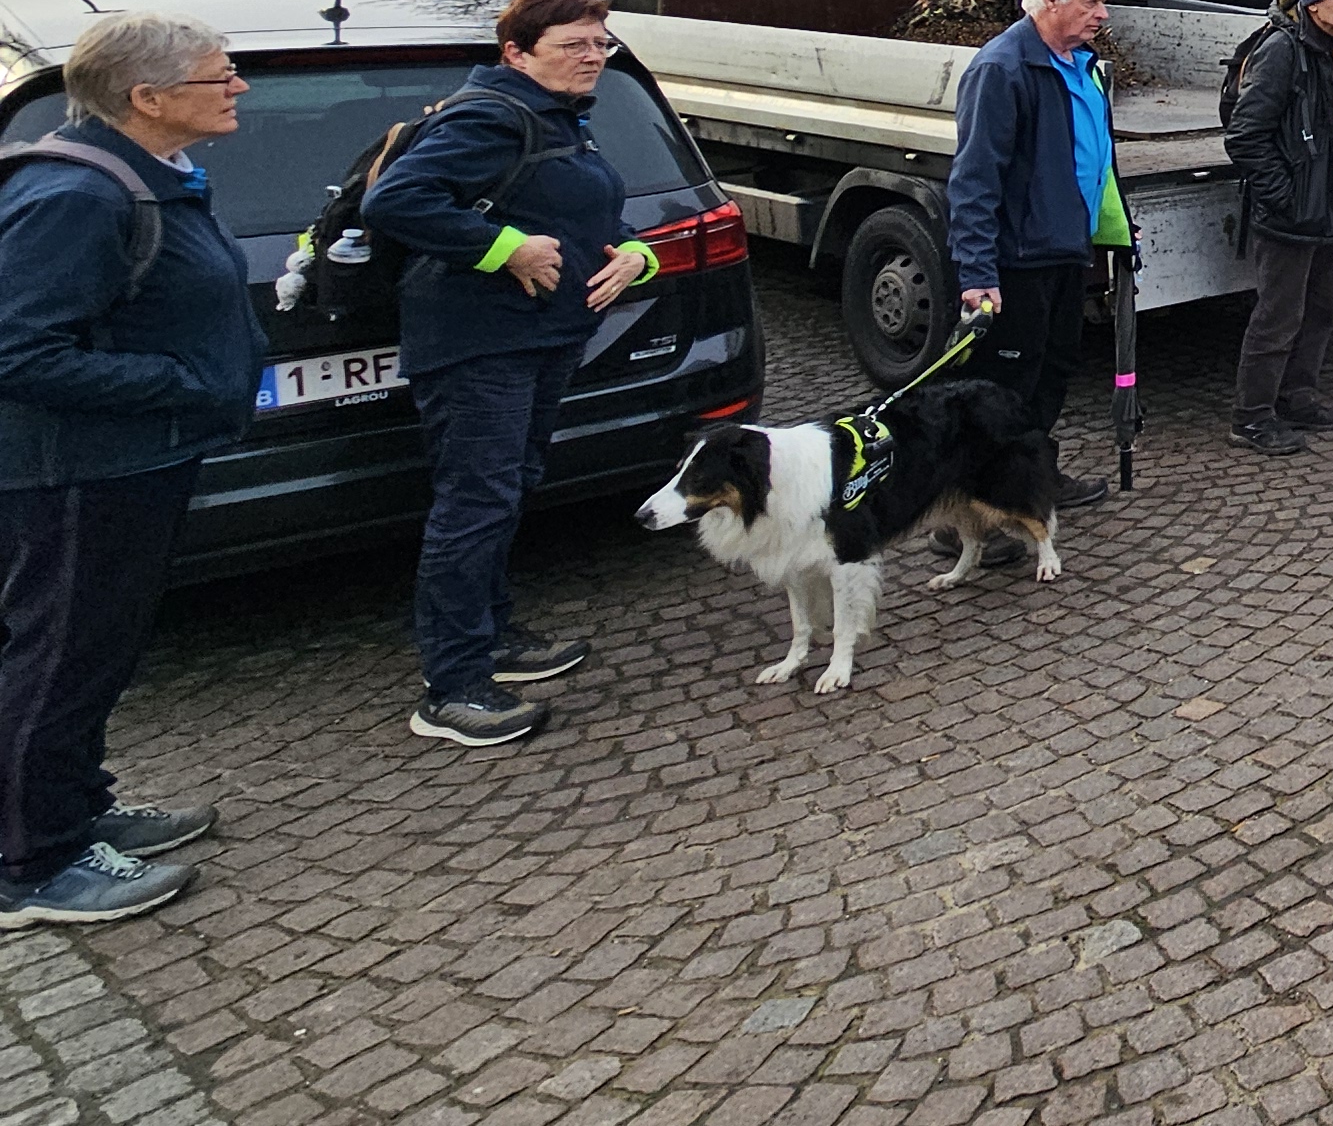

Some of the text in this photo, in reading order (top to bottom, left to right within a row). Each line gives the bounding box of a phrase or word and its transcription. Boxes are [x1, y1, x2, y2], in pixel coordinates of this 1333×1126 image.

[287, 351, 398, 398] 1-RF
[256, 390, 273, 407] B
[335, 391, 389, 407] LAGROU
